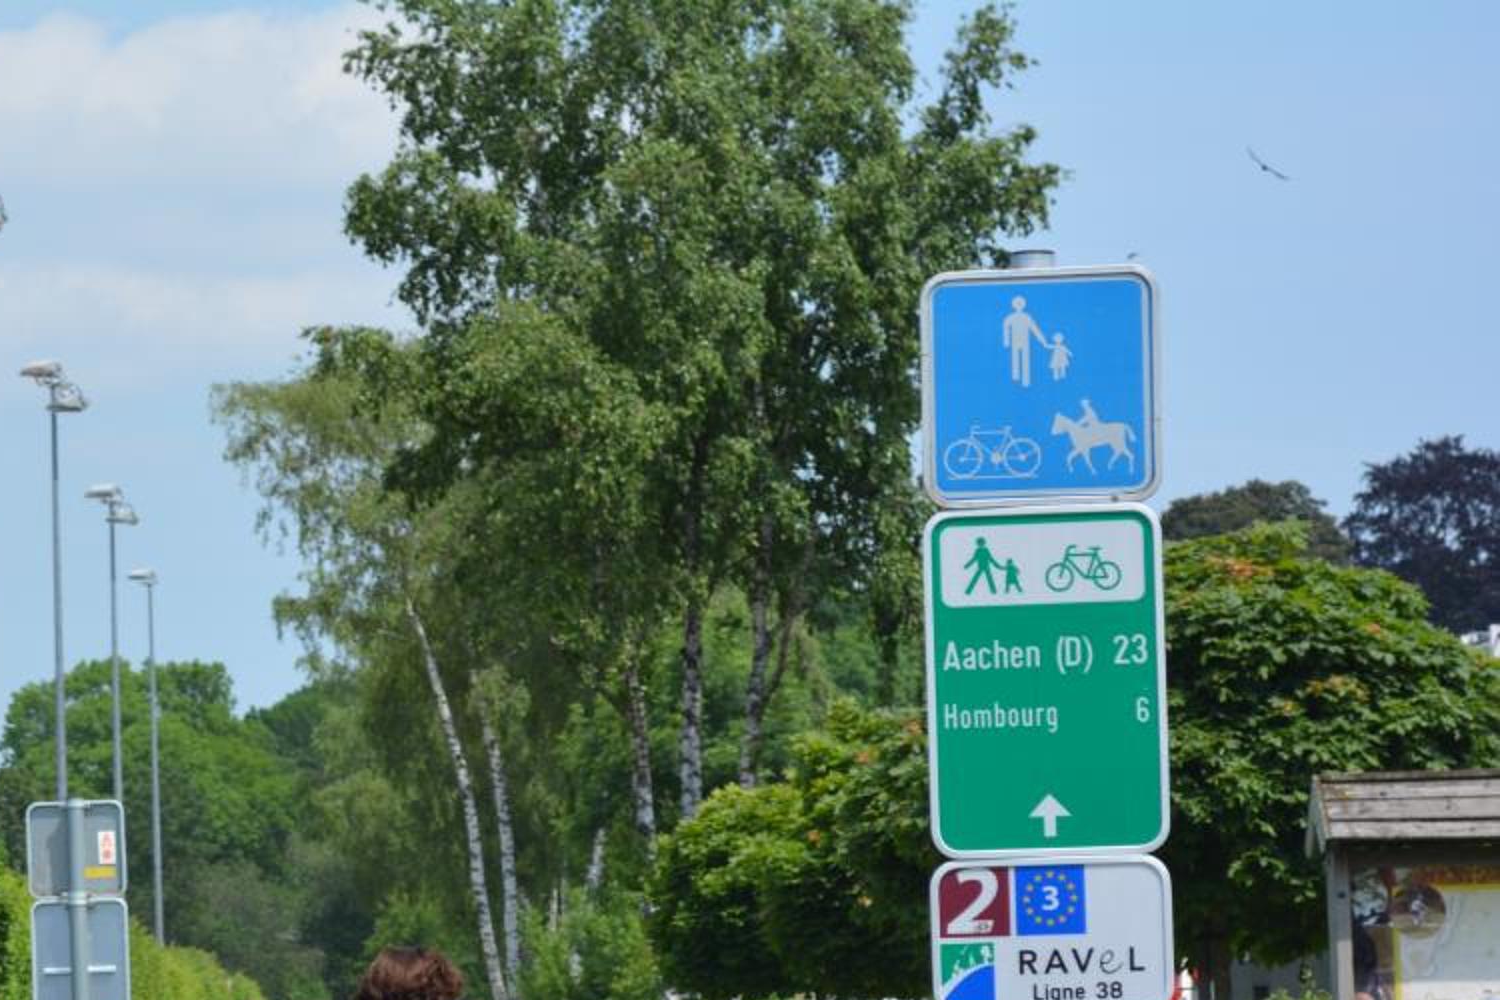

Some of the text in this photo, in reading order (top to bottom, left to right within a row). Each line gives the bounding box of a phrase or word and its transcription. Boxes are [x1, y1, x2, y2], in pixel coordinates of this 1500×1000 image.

[943, 633, 1149, 674] Aachen (D) 23
[943, 696, 1150, 733] Hombourg 6
[947, 869, 999, 935] 2
[1041, 886, 1059, 911] 3
[1096, 981, 1123, 999] 38
